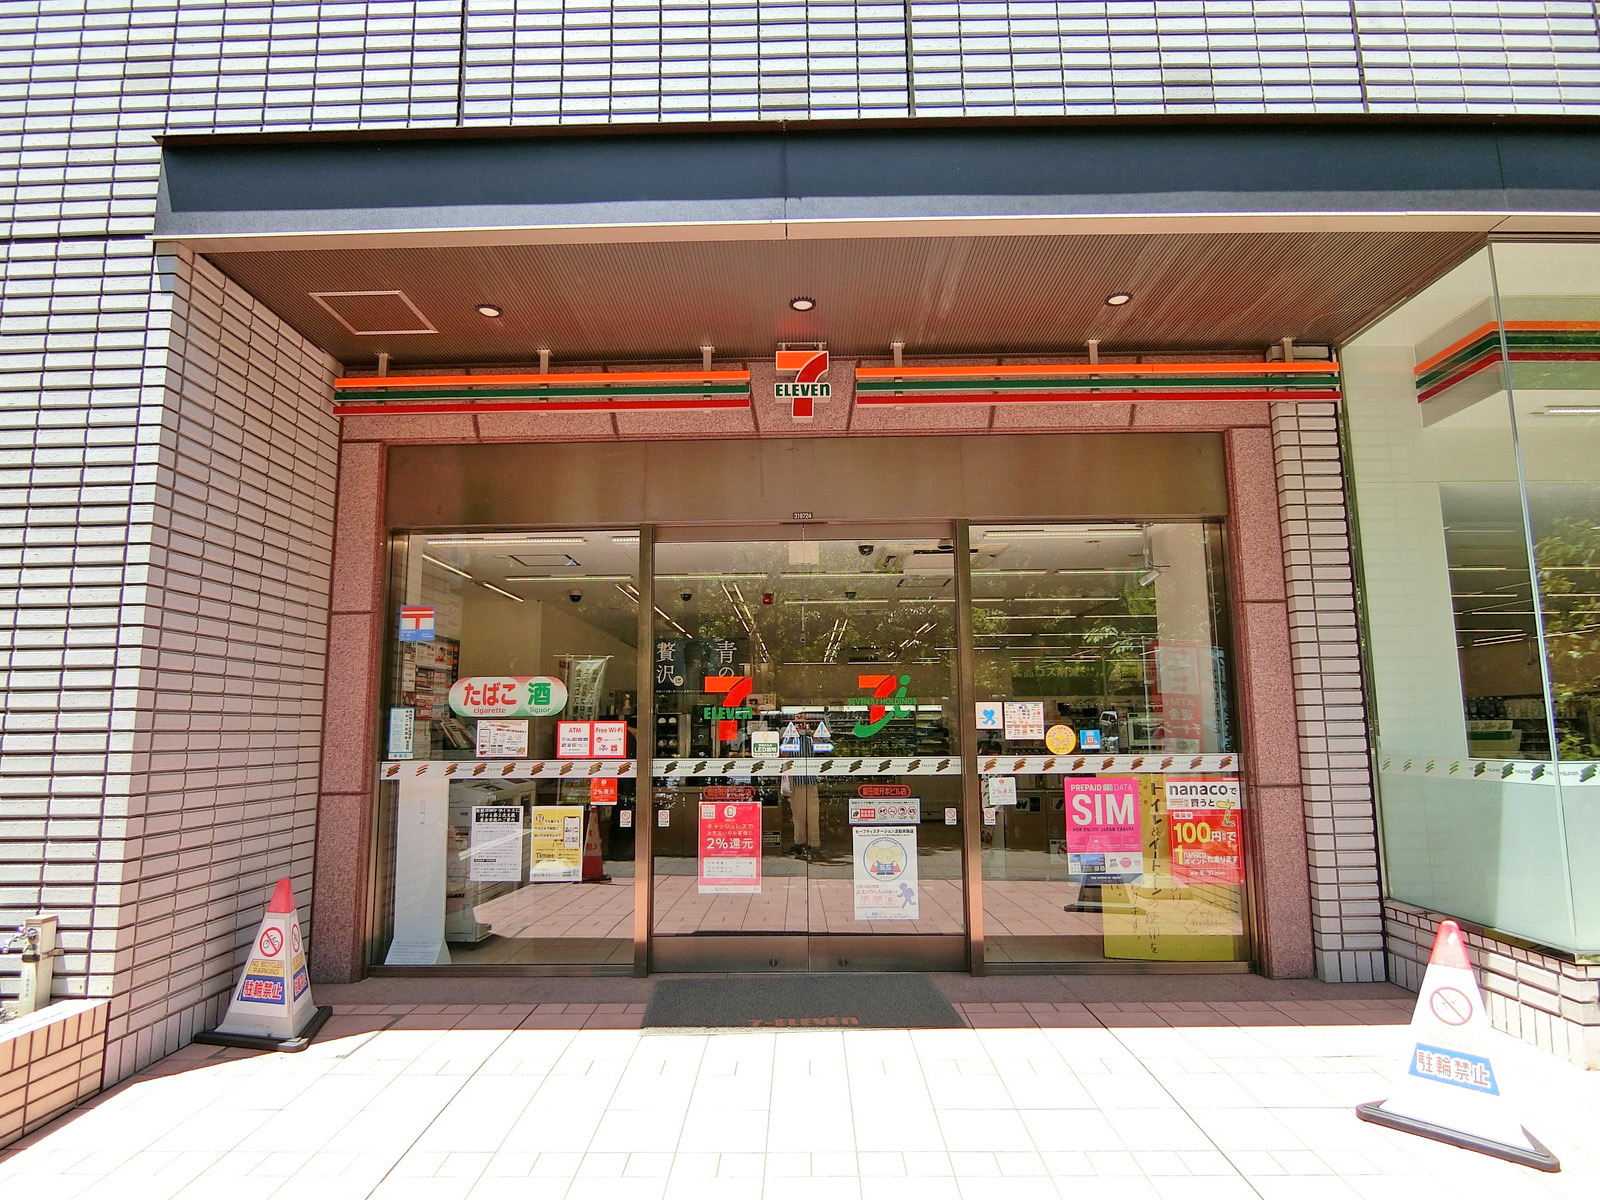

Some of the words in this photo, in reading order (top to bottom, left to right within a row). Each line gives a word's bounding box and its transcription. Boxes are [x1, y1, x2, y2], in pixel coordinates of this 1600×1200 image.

[775, 383, 830, 397] ELEVEN
[463, 681, 517, 706] たばこ
[527, 682, 551, 706] 酒
[703, 707, 753, 720] ELEVEN
[1114, 783, 1133, 791] DATA
[1071, 793, 1135, 826] SIM
[1190, 799, 1215, 807] 買うと
[706, 837, 754, 850] 2%還元
[253, 968, 280, 976] PARKING
[245, 979, 282, 999] 駐輪禁止
[747, 1016, 859, 1027] 7-ELEVEN
[1417, 1051, 1490, 1086] 駐輪禁止
